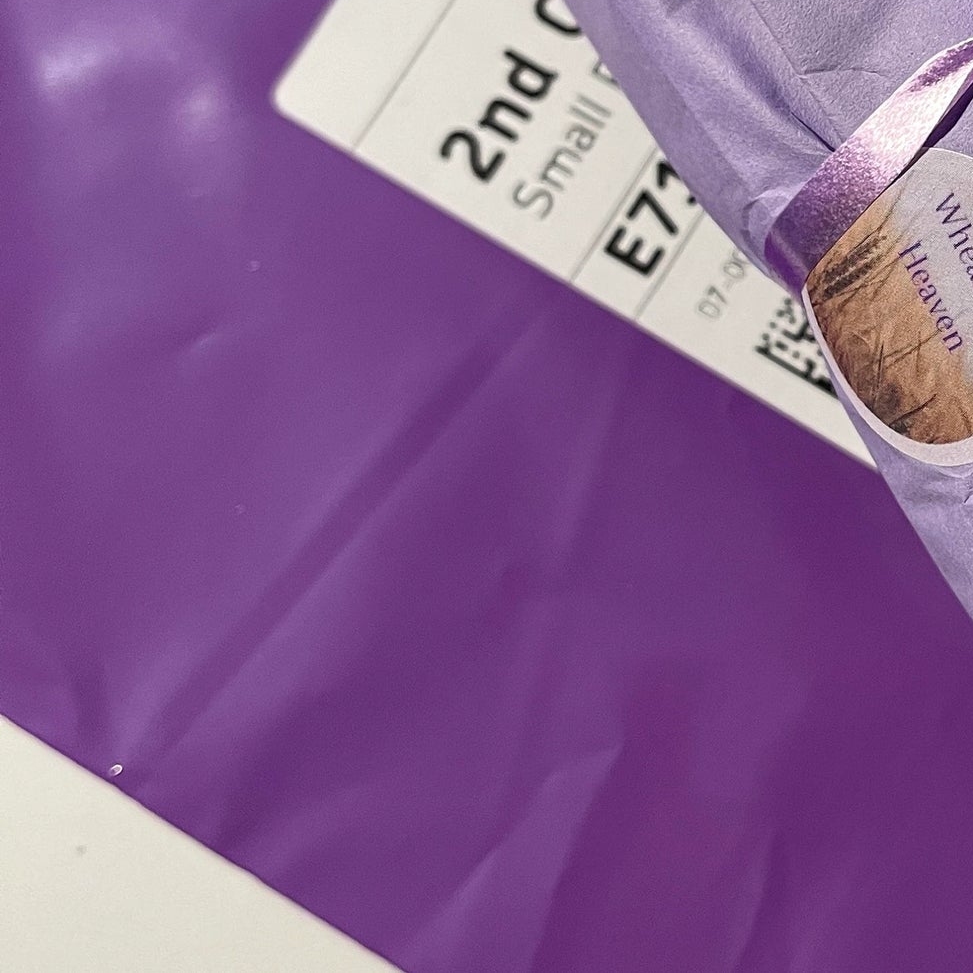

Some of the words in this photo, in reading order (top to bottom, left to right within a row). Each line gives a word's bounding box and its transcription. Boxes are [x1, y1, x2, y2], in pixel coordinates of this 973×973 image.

[440, 47, 558, 182] 2nd
[512, 94, 612, 219] Small
[898, 239, 964, 352] Heaven
